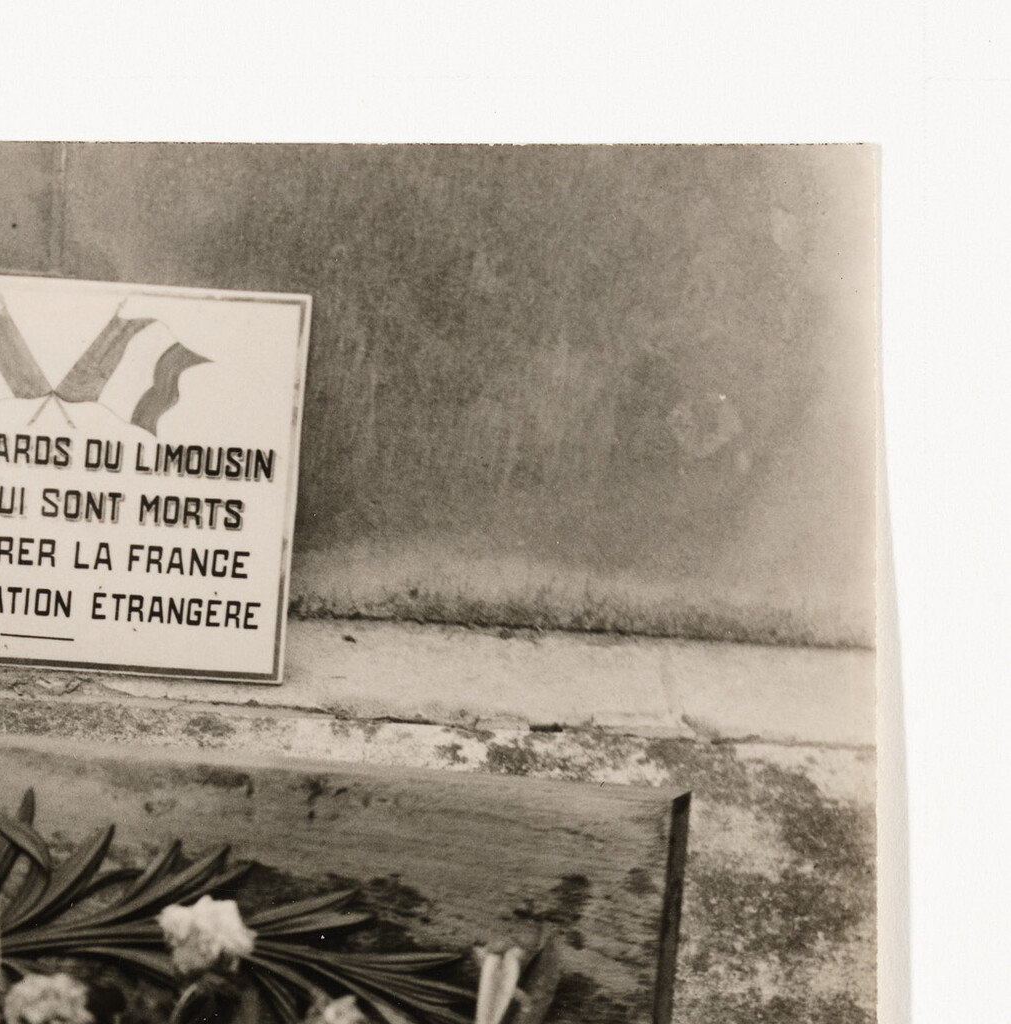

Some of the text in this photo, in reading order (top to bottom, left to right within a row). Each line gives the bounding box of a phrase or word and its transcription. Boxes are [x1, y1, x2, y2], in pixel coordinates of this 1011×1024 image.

[85, 438, 123, 472] DU
[135, 442, 275, 482] LIMOUSIN
[41, 488, 124, 523] SONT
[138, 494, 244, 531] MORTS
[73, 541, 112, 571] LA
[127, 544, 251, 579] FRANCE
